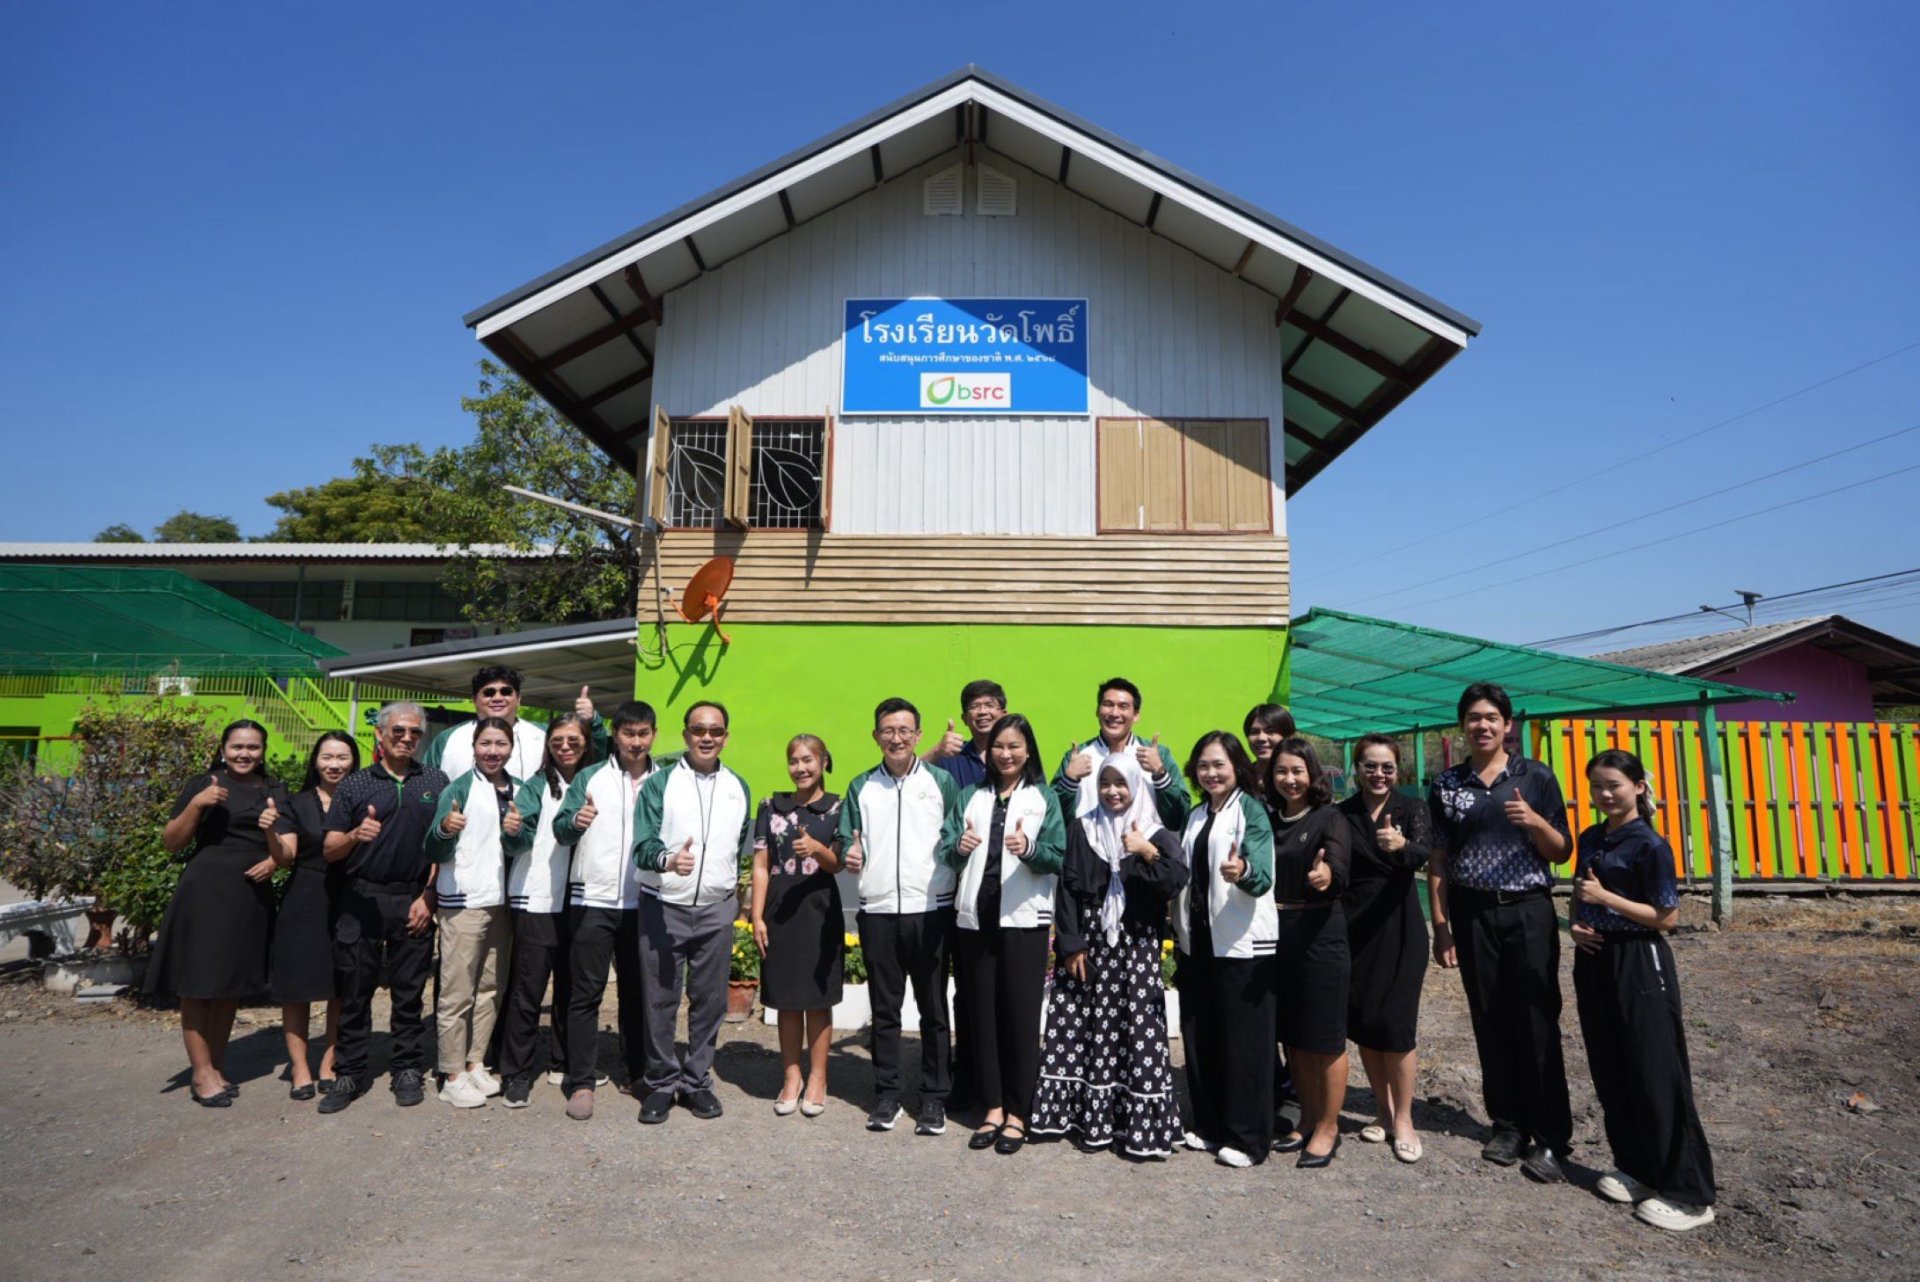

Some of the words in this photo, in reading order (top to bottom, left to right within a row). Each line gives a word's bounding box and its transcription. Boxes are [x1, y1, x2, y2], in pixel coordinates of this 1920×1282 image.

[860, 305, 1080, 344] โรงเรียนวัดโพธิ์
[957, 384, 1004, 401] bsrc
